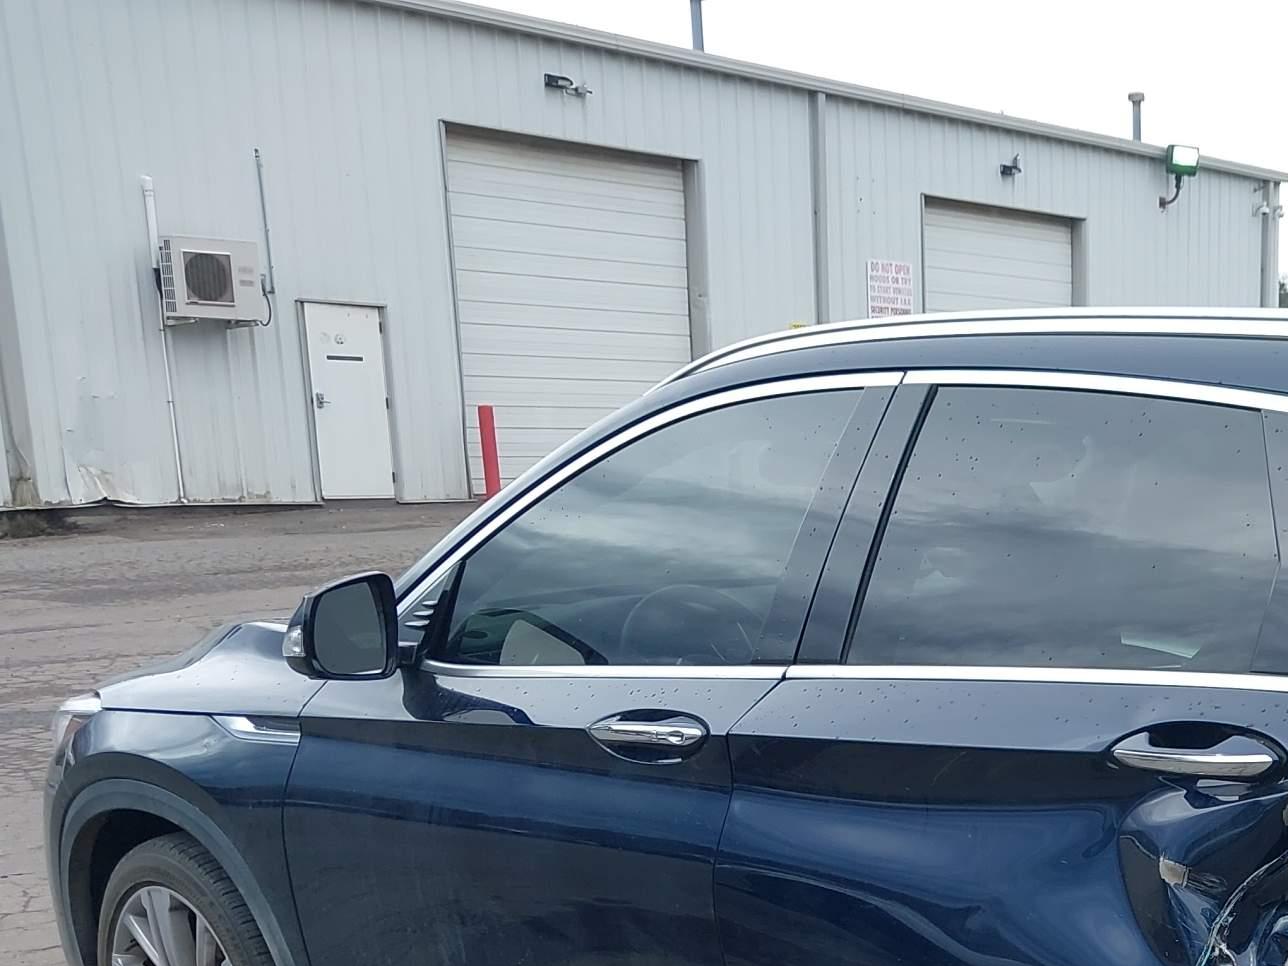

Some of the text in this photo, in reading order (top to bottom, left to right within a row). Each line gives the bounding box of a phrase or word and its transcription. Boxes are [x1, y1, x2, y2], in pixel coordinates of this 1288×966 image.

[871, 261, 910, 275] DO NOT OPEN
[891, 276, 899, 285] OR
